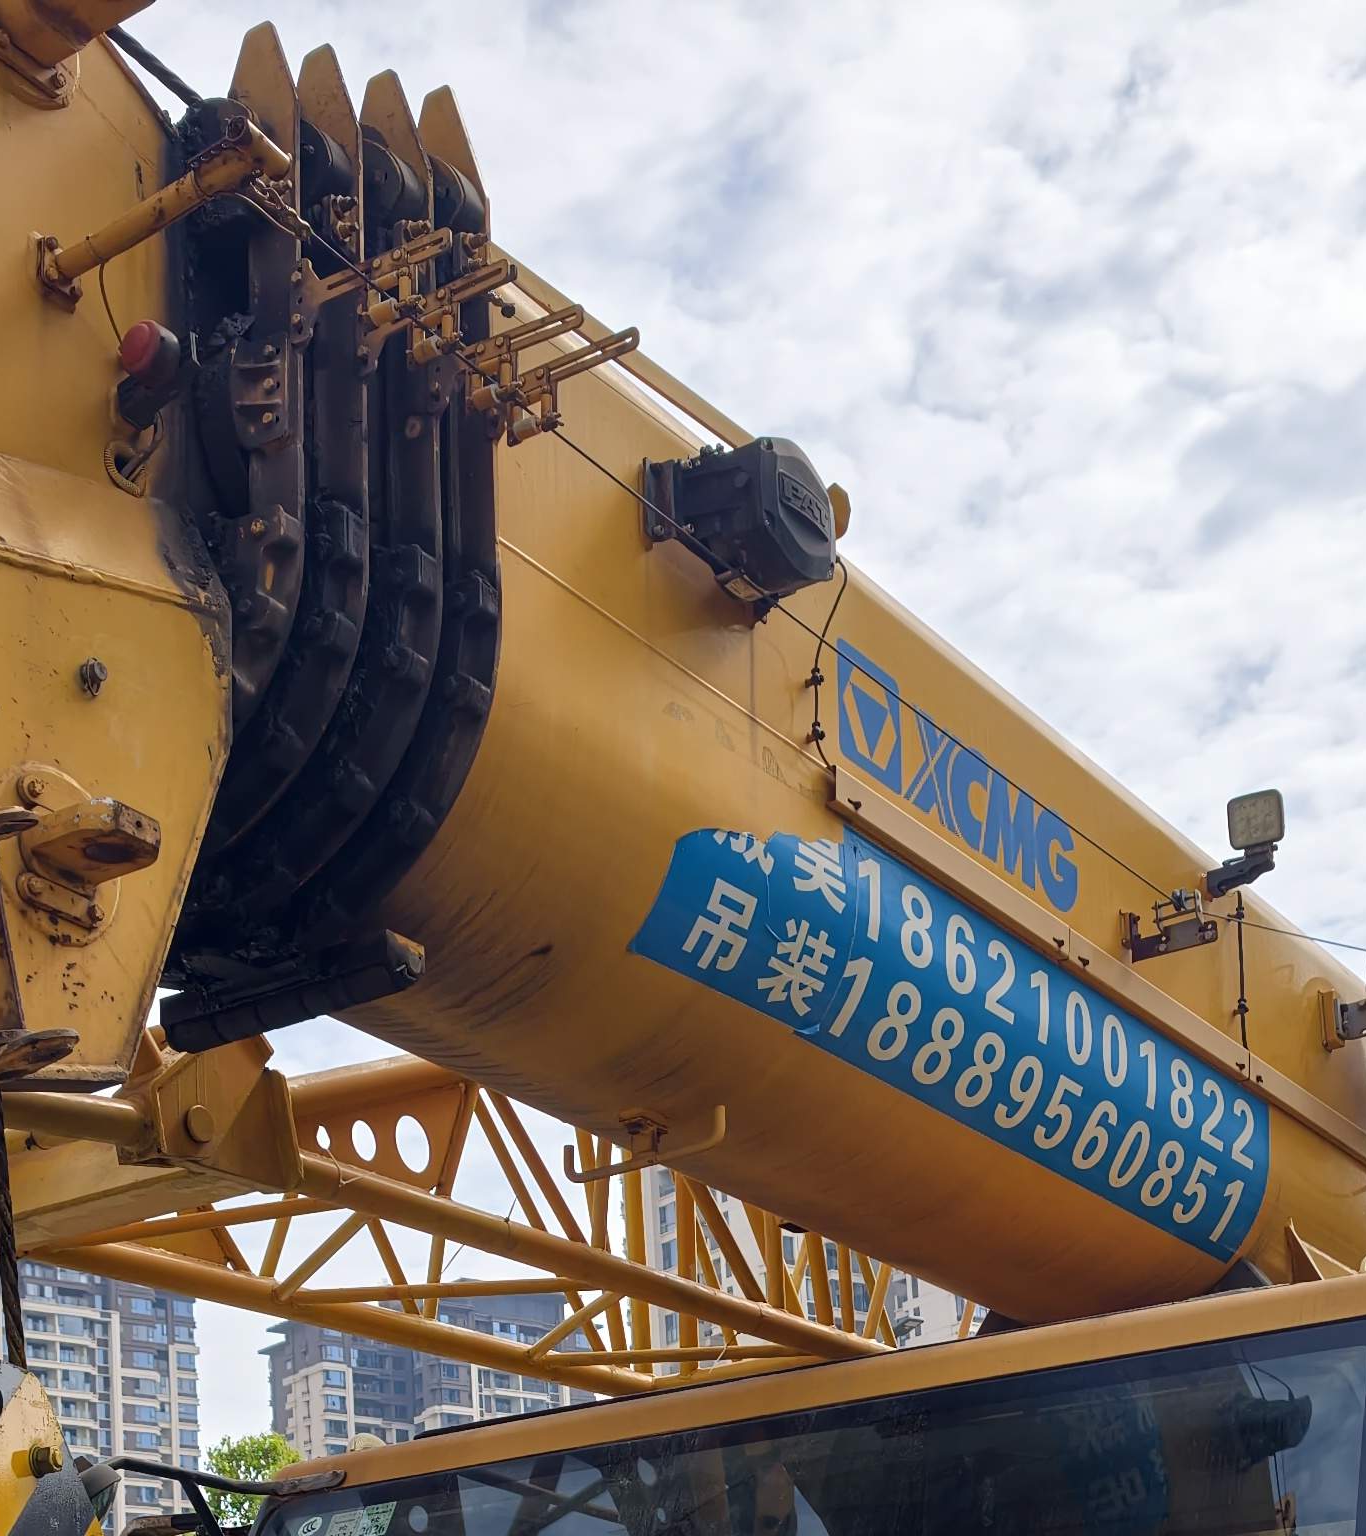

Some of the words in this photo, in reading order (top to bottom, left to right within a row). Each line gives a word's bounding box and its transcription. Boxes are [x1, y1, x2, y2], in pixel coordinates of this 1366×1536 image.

[904, 704, 1079, 913] XCMG
[680, 876, 837, 1017] 吊装
[833, 956, 1248, 1244] 18889560851
[857, 857, 1257, 1171] 18621001822
